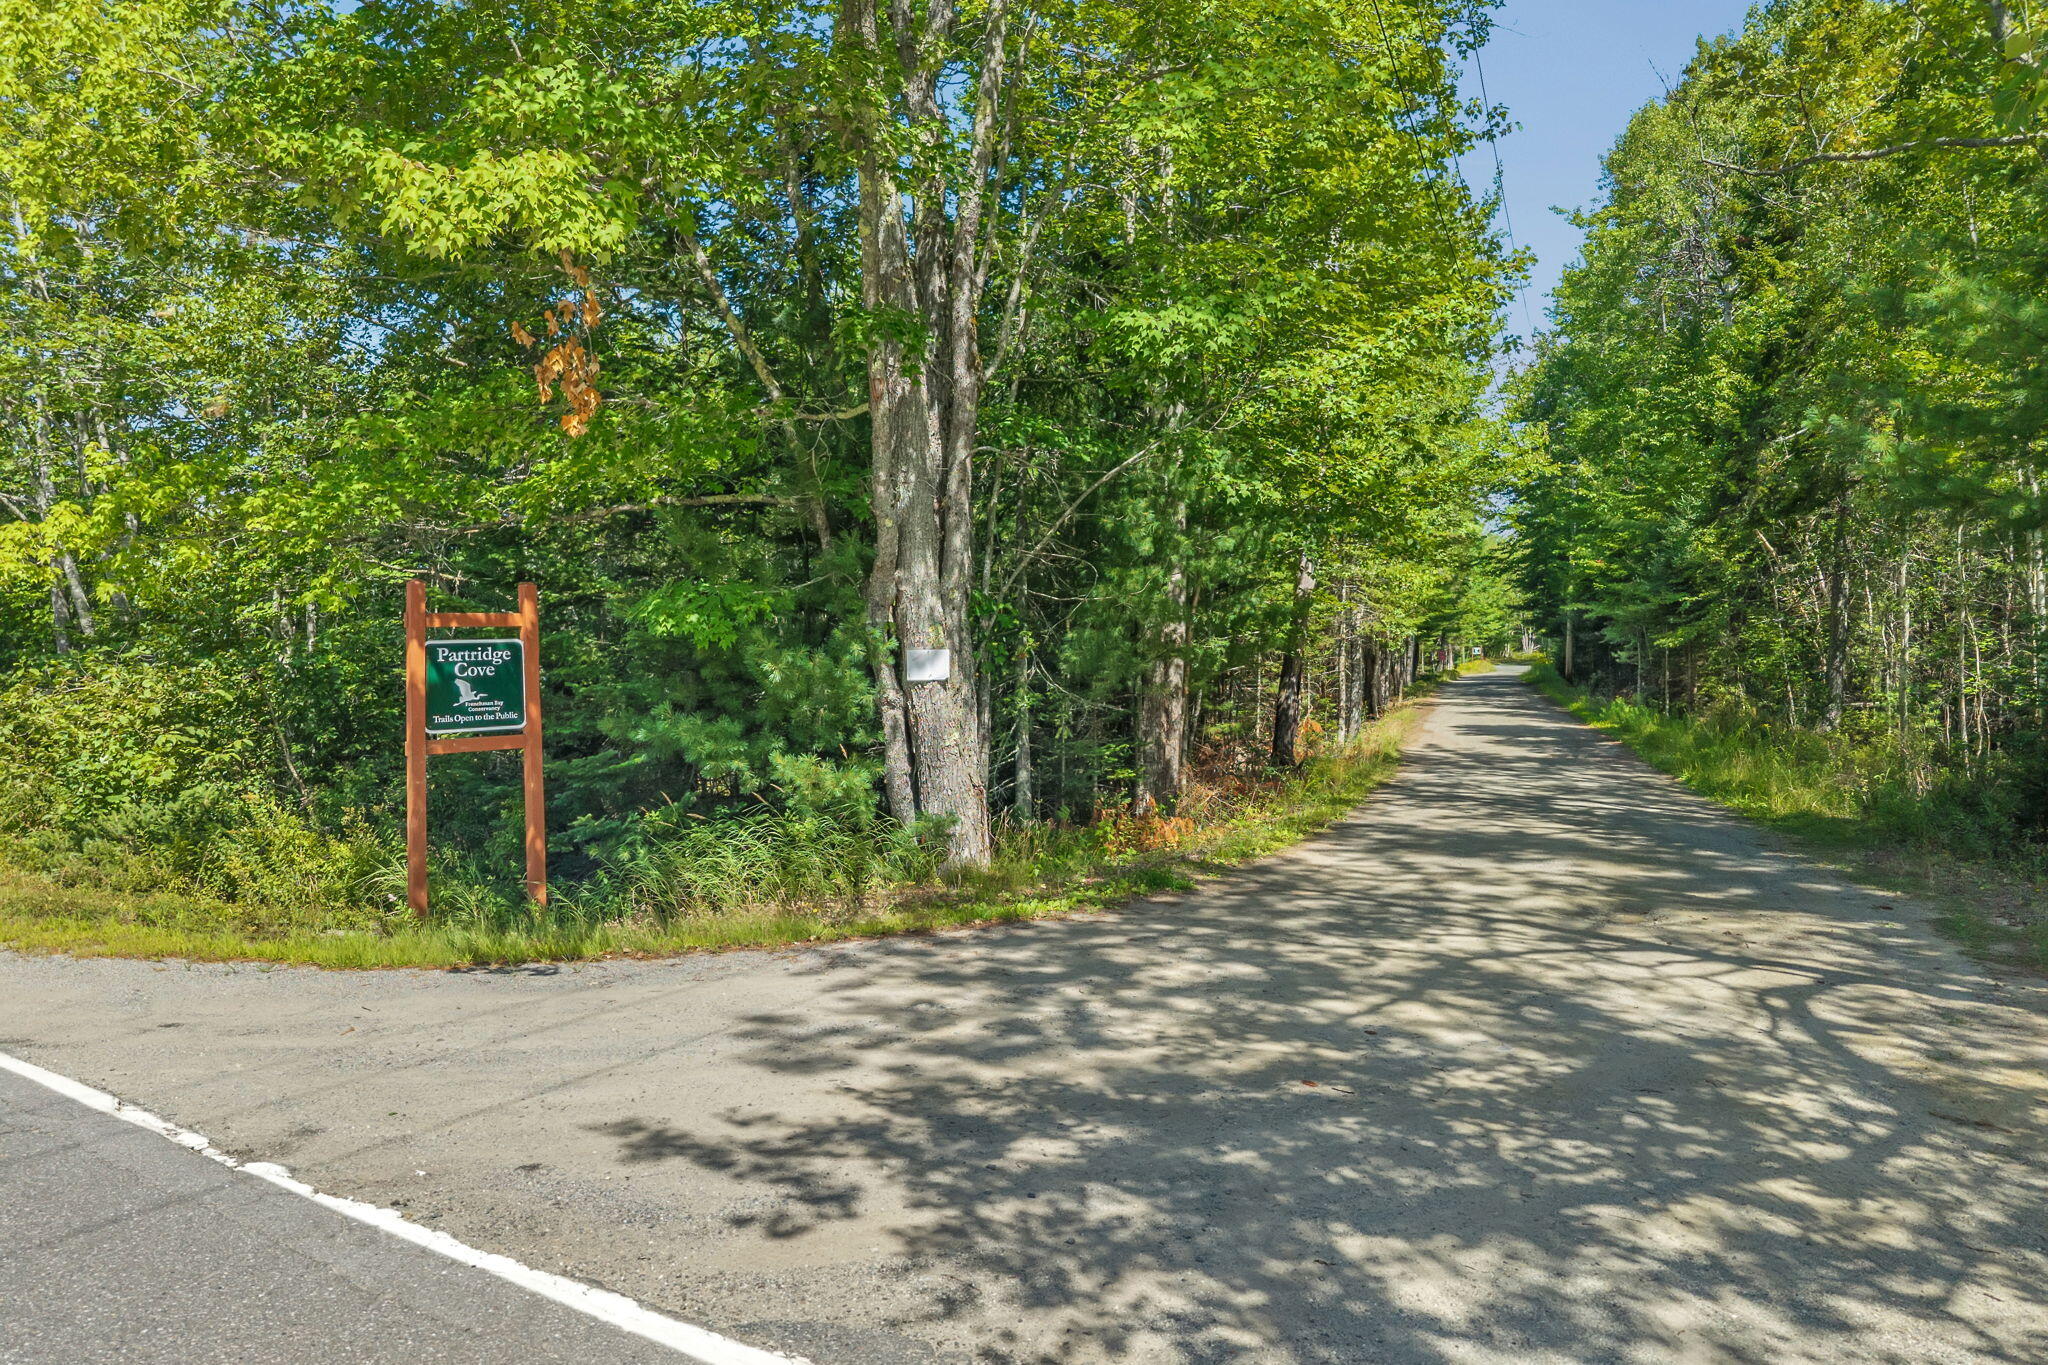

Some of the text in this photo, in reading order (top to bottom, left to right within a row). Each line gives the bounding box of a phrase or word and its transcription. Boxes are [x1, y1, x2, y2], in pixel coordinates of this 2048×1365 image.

[437, 647, 511, 664] Partridge
[454, 662, 495, 677] Cove
[432, 715, 453, 723] Trails
[454, 714, 474, 723] Open
[495, 711, 518, 719] Public
